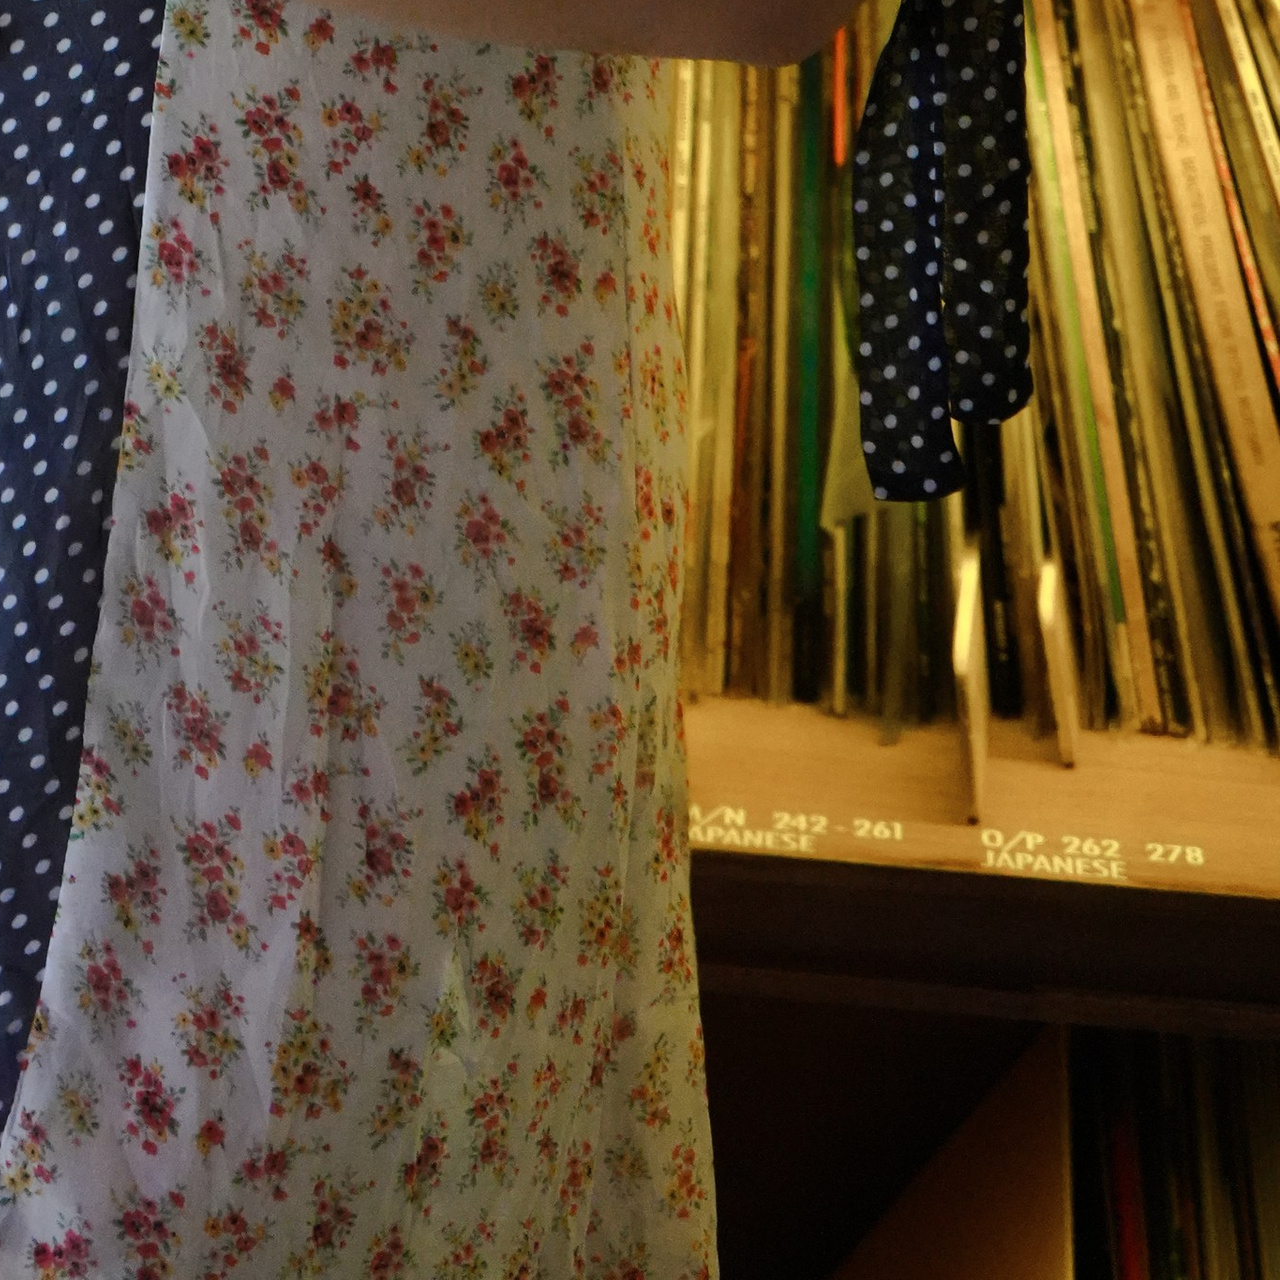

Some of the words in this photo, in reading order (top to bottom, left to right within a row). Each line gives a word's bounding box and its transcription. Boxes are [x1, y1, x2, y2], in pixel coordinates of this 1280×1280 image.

[687, 824, 815, 853] APANESE
[1061, 835, 1120, 858] 262
[1145, 842, 1205, 866] 278
[980, 850, 1127, 880] JAPANESE
